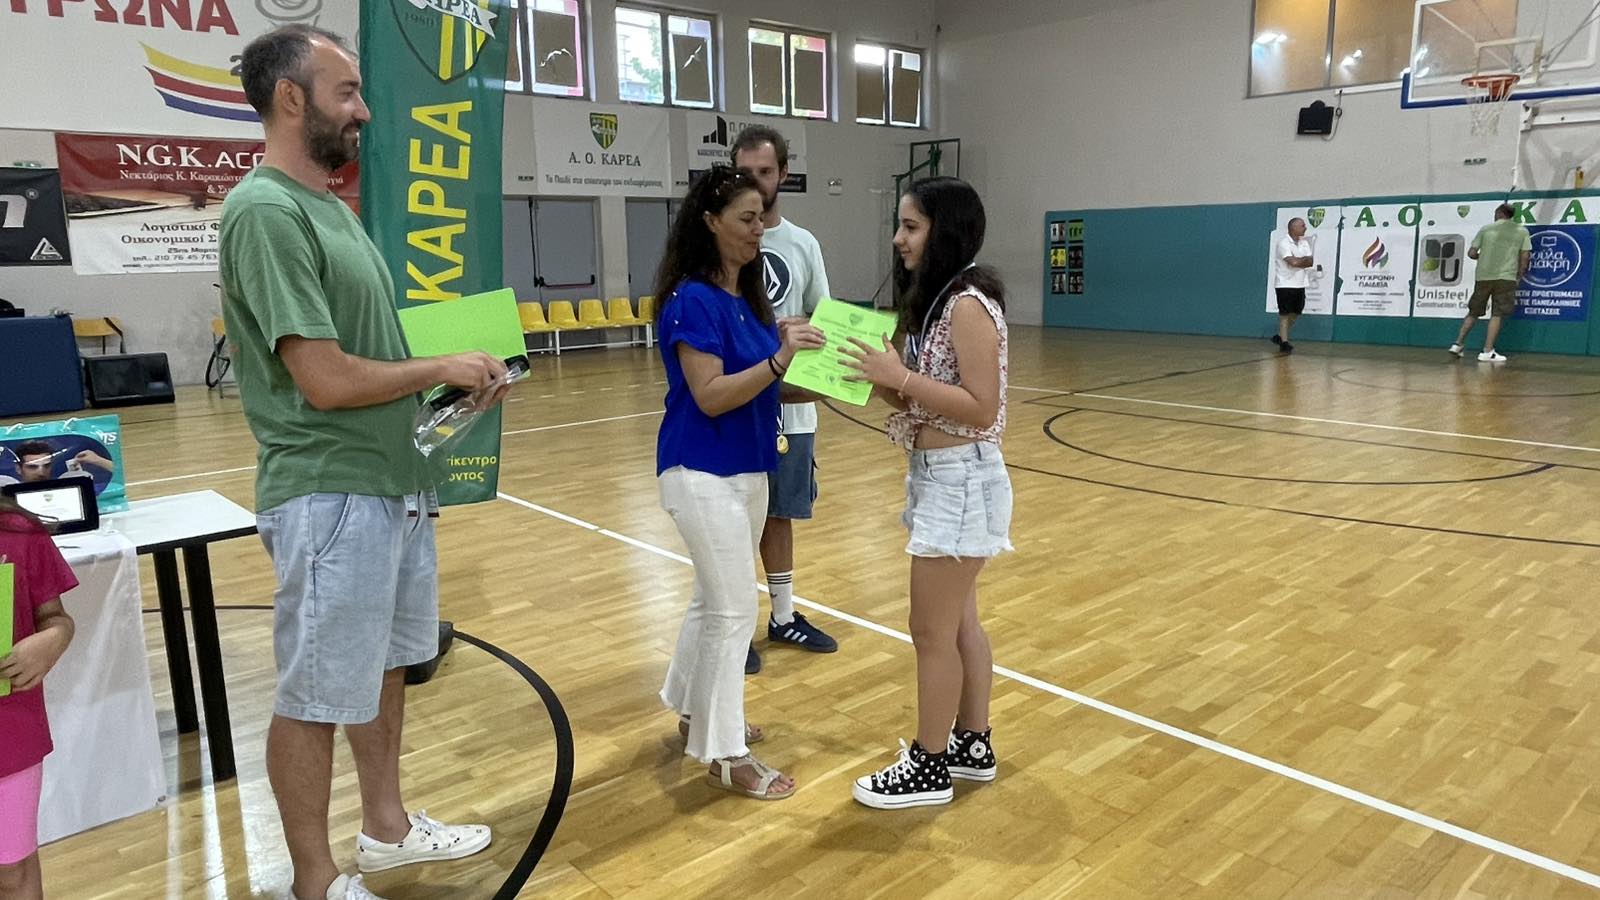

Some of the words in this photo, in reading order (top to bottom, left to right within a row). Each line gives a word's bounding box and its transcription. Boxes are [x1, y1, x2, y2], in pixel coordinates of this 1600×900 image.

[601, 153, 641, 167] ΚΑΡΕΑ
[120, 169, 174, 182] Νεκτάριος
[406, 101, 473, 301] ΚΑΡΕΑ
[140, 222, 207, 233] Λογιστικό
[121, 234, 204, 245] Οικονομικοί
[1417, 288, 1469, 301] Unisteel
